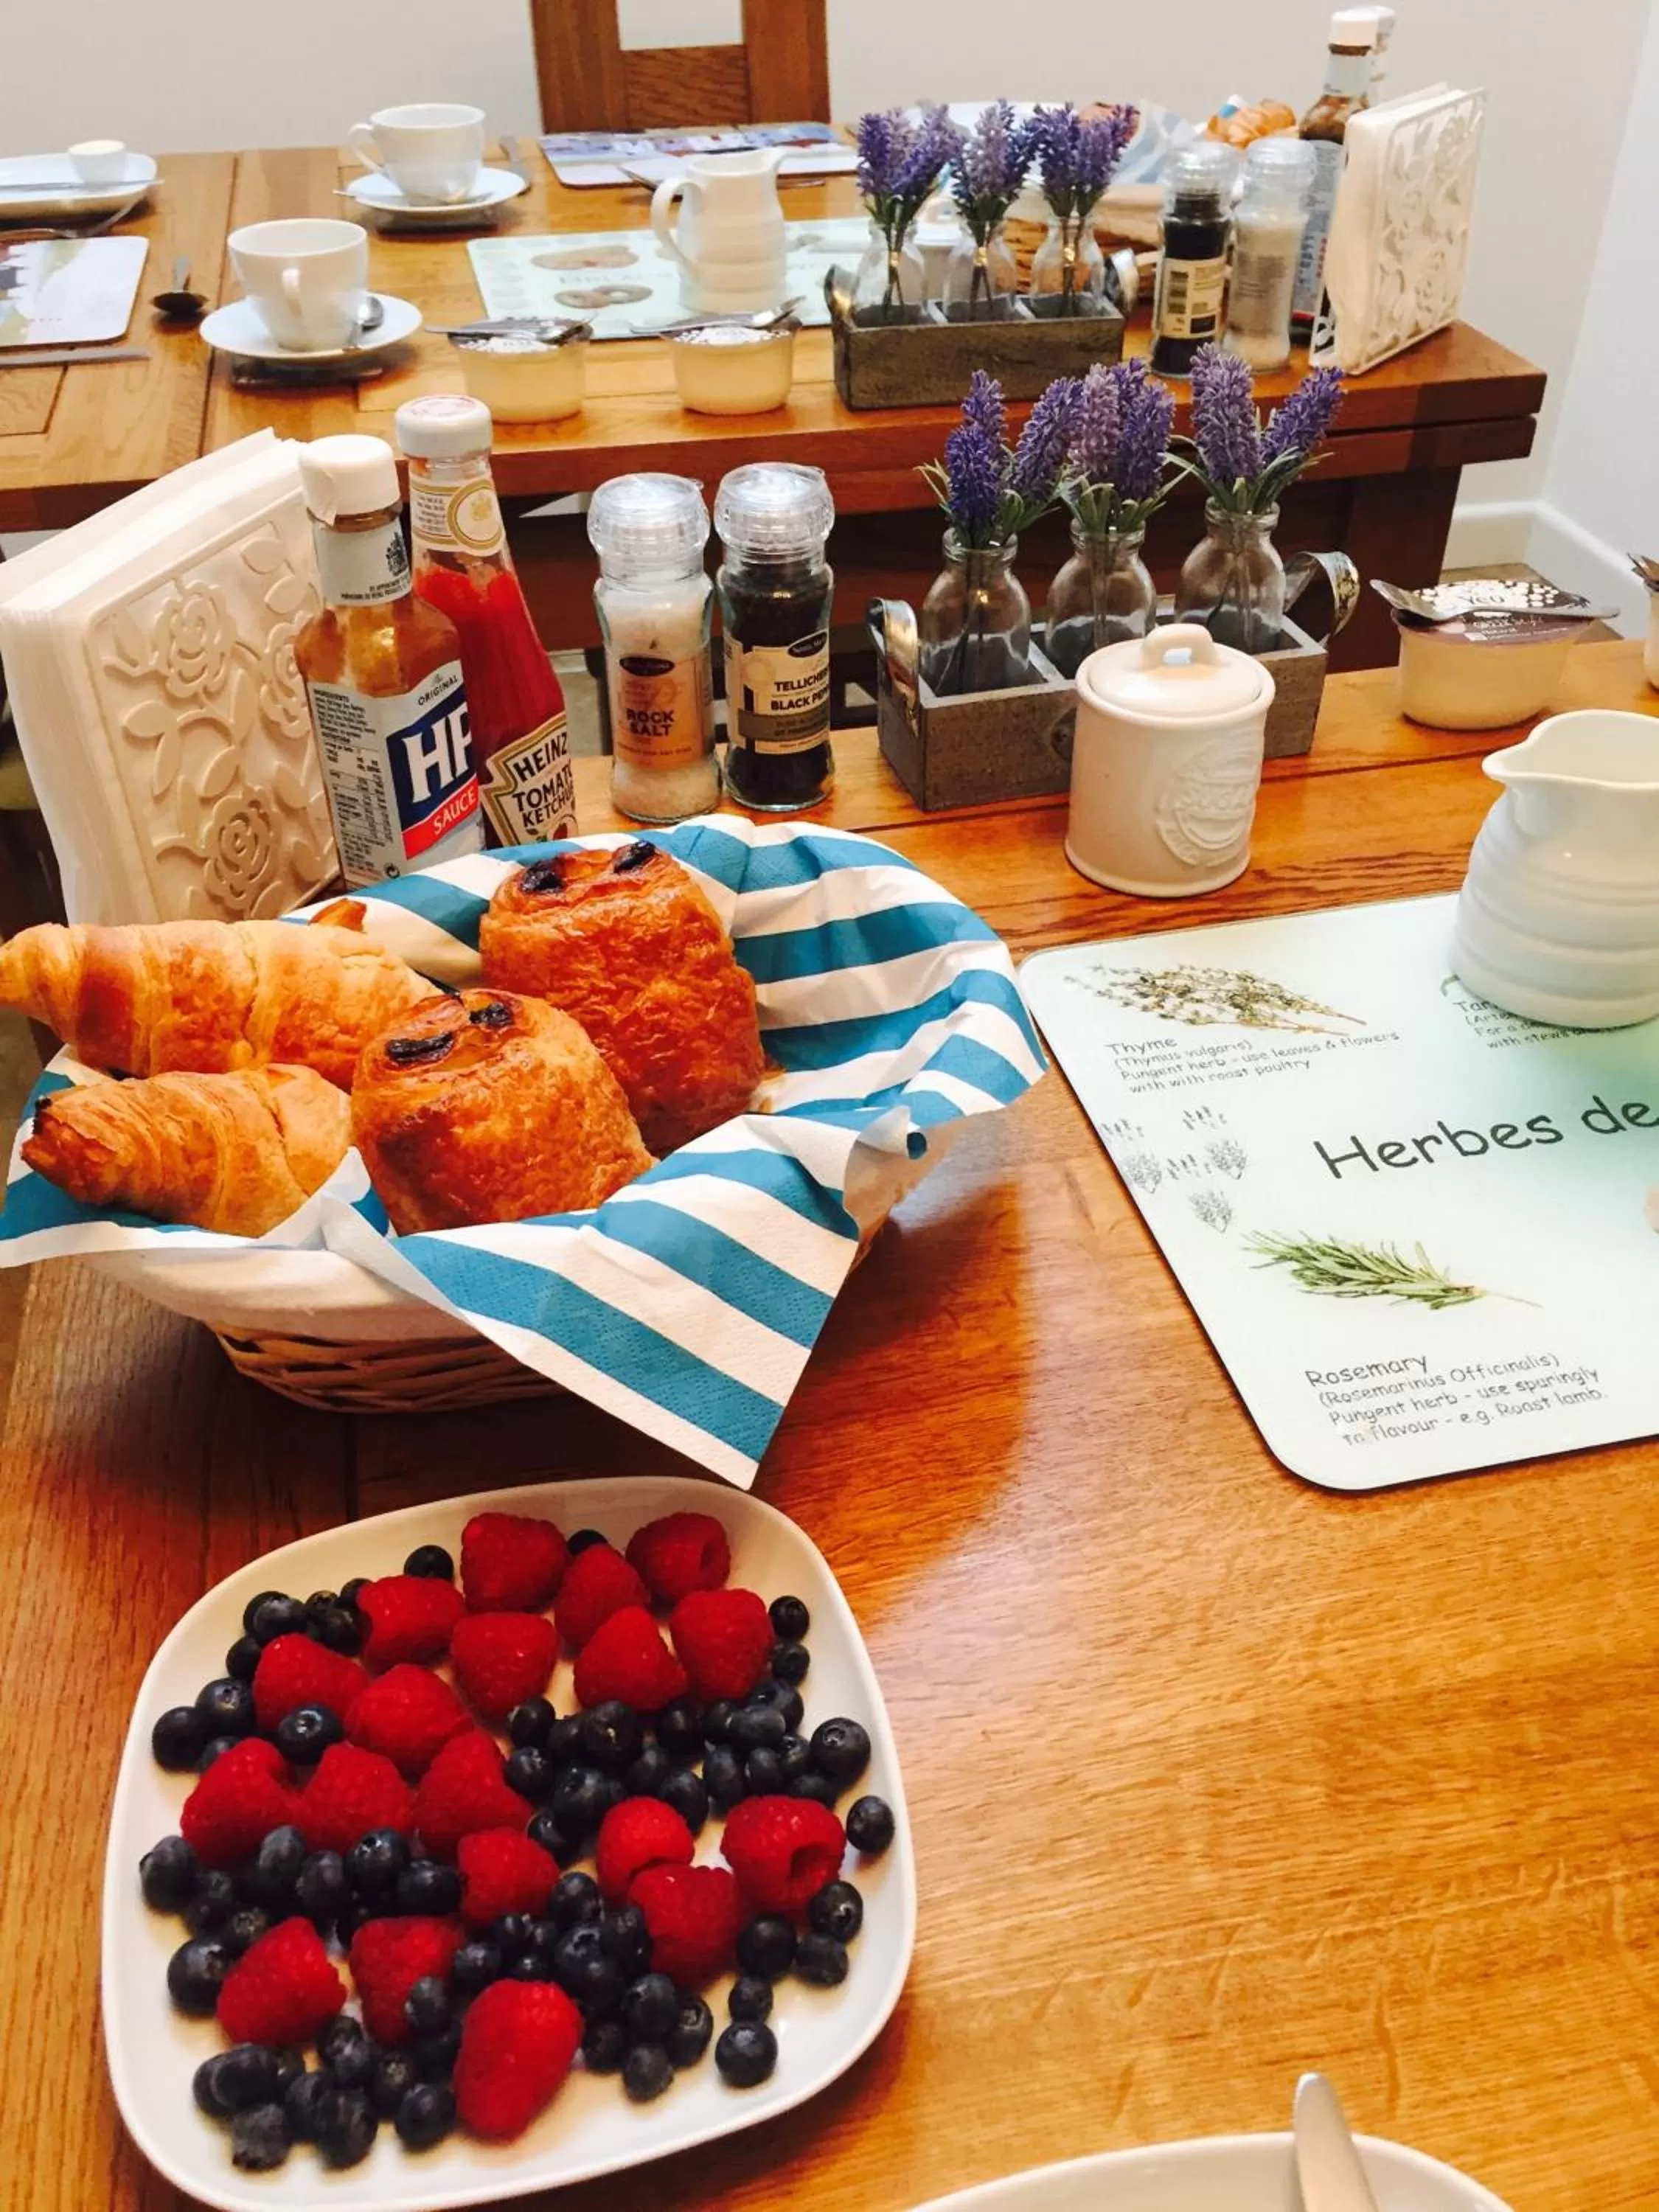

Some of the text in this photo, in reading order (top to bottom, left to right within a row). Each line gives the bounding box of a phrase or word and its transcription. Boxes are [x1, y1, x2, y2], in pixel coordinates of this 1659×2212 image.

[417, 675, 459, 706] ORIGINAL
[771, 697, 810, 712] BLACK
[626, 708, 675, 723] ROCK
[630, 722, 672, 737] SALT
[512, 731, 568, 782] HEINZ
[432, 788, 476, 835] SAUCE
[1103, 1038, 1178, 1055] Thyme
[1121, 1063, 1183, 1080] Pungent
[1188, 1058, 1226, 1071] herb
[1241, 1051, 1269, 1062] use
[1271, 1043, 1321, 1057] leaves
[1339, 1032, 1400, 1048] flowers
[1486, 1036, 1522, 1049] with
[1113, 1052, 1182, 1070] (Thymus
[1129, 1059, 1310, 1094] with with roast poultry
[1313, 1094, 1659, 1179] Herbes de
[1304, 1354, 1428, 1388] Rosemary
[1318, 1352, 1561, 1408] (Rosemarinus Officinalis)
[1328, 1403, 1406, 1426] Pungent
[1413, 1391, 1458, 1411] herb
[1475, 1383, 1512, 1400] use
[1516, 1366, 1600, 1394] sparingly
[1497, 1399, 1554, 1418] Roast
